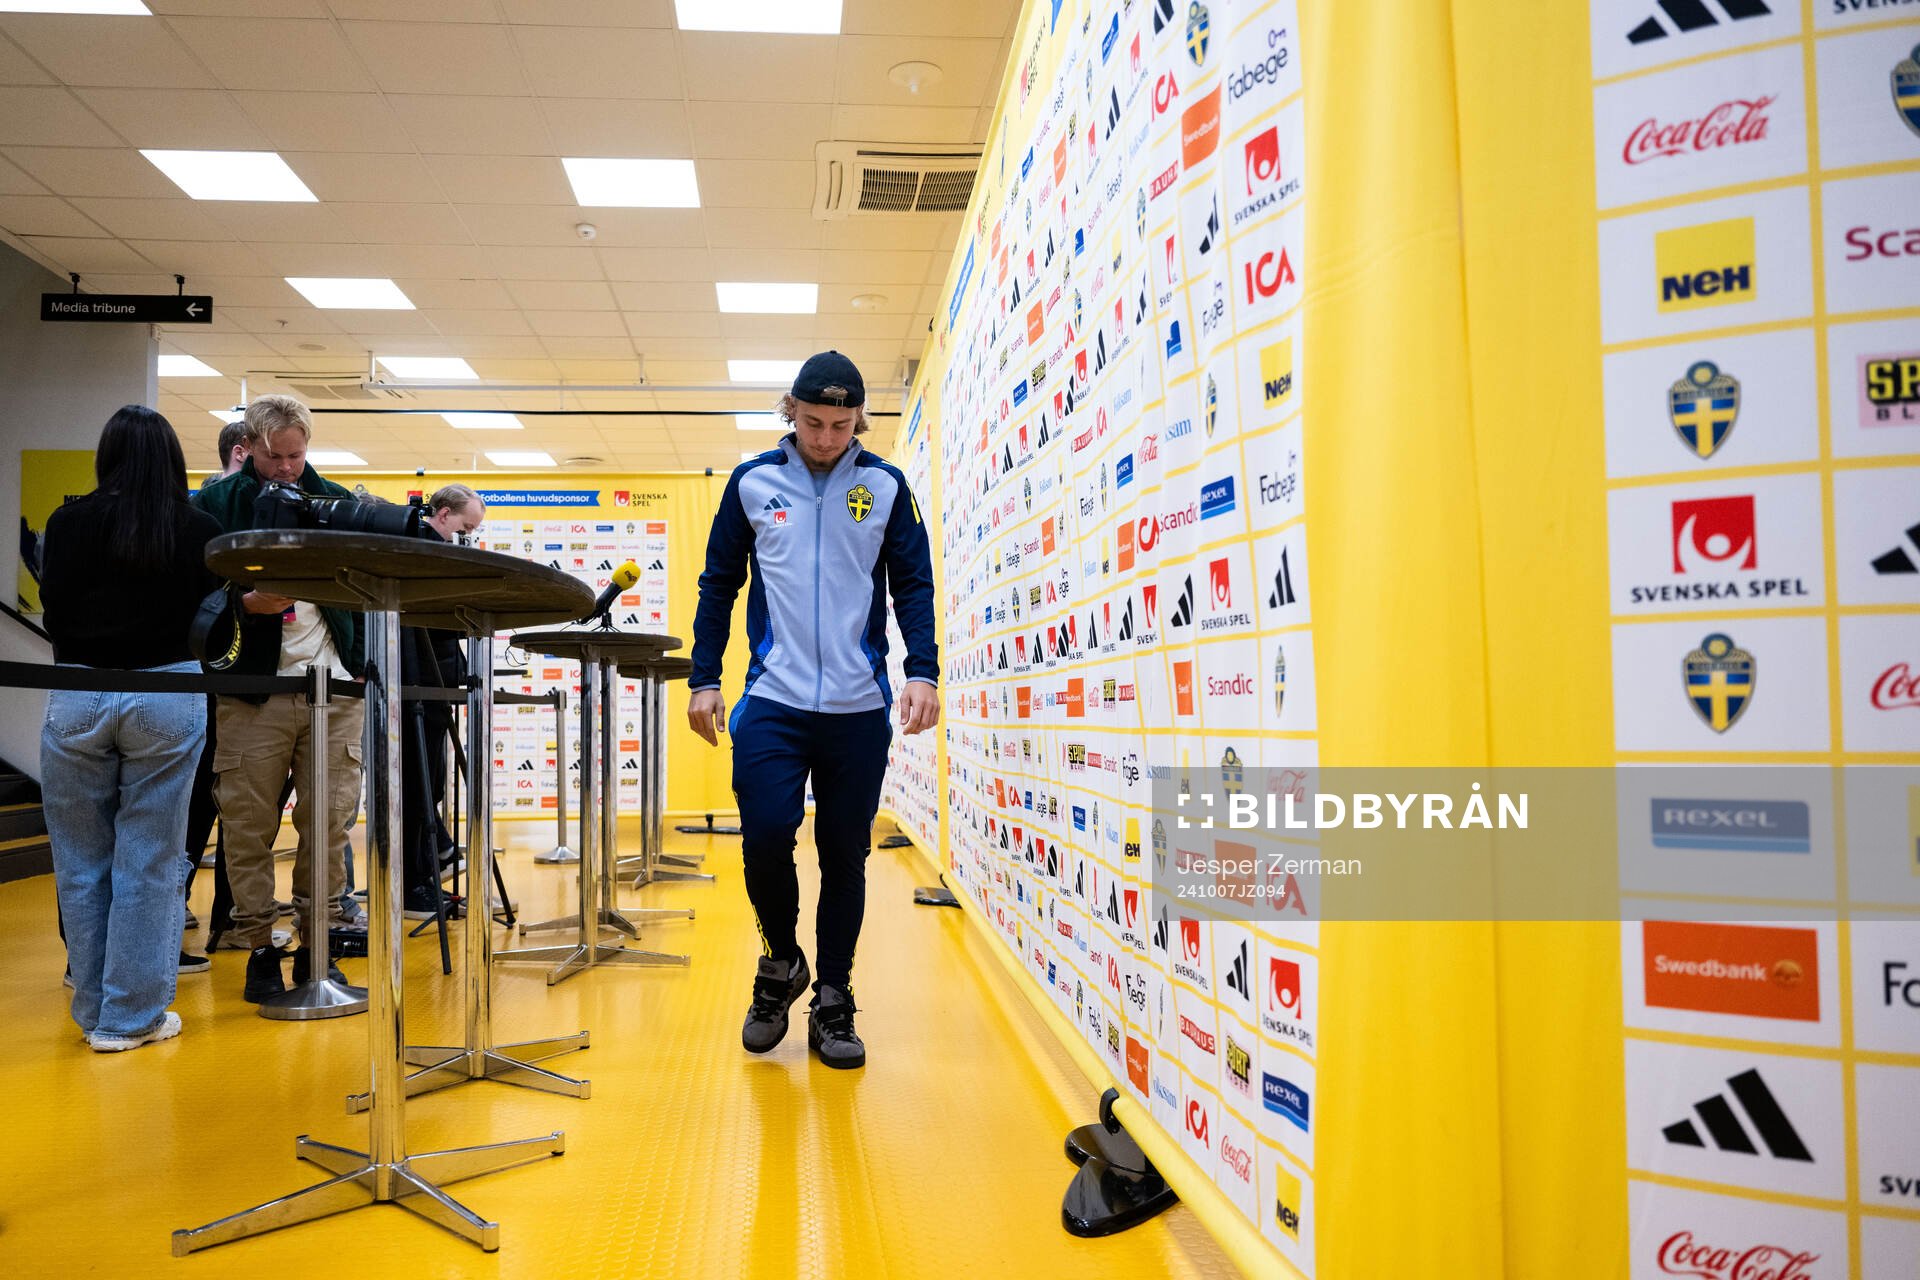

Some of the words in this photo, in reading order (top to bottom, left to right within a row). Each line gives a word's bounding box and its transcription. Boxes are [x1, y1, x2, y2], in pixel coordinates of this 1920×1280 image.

[1151, 69, 1179, 122] ICA
[1234, 193, 1276, 225] SVENSKA
[1278, 178, 1300, 201] SPEL
[1245, 246, 1295, 305] ICA
[51, 302, 89, 313] Media
[93, 302, 136, 314] tribune
[526, 493, 590, 504] huvudsponsor
[571, 525, 587, 533] ICA
[1631, 581, 1740, 604] SVENSKA
[1748, 578, 1808, 598] SPEL
[1229, 613, 1251, 628] SPEL
[1208, 674, 1254, 697] Scandic
[518, 780, 533, 788] ICA
[1107, 953, 1120, 993] ICA
[1655, 954, 1768, 982] Swedbank
[1186, 1095, 1208, 1149] ICA
